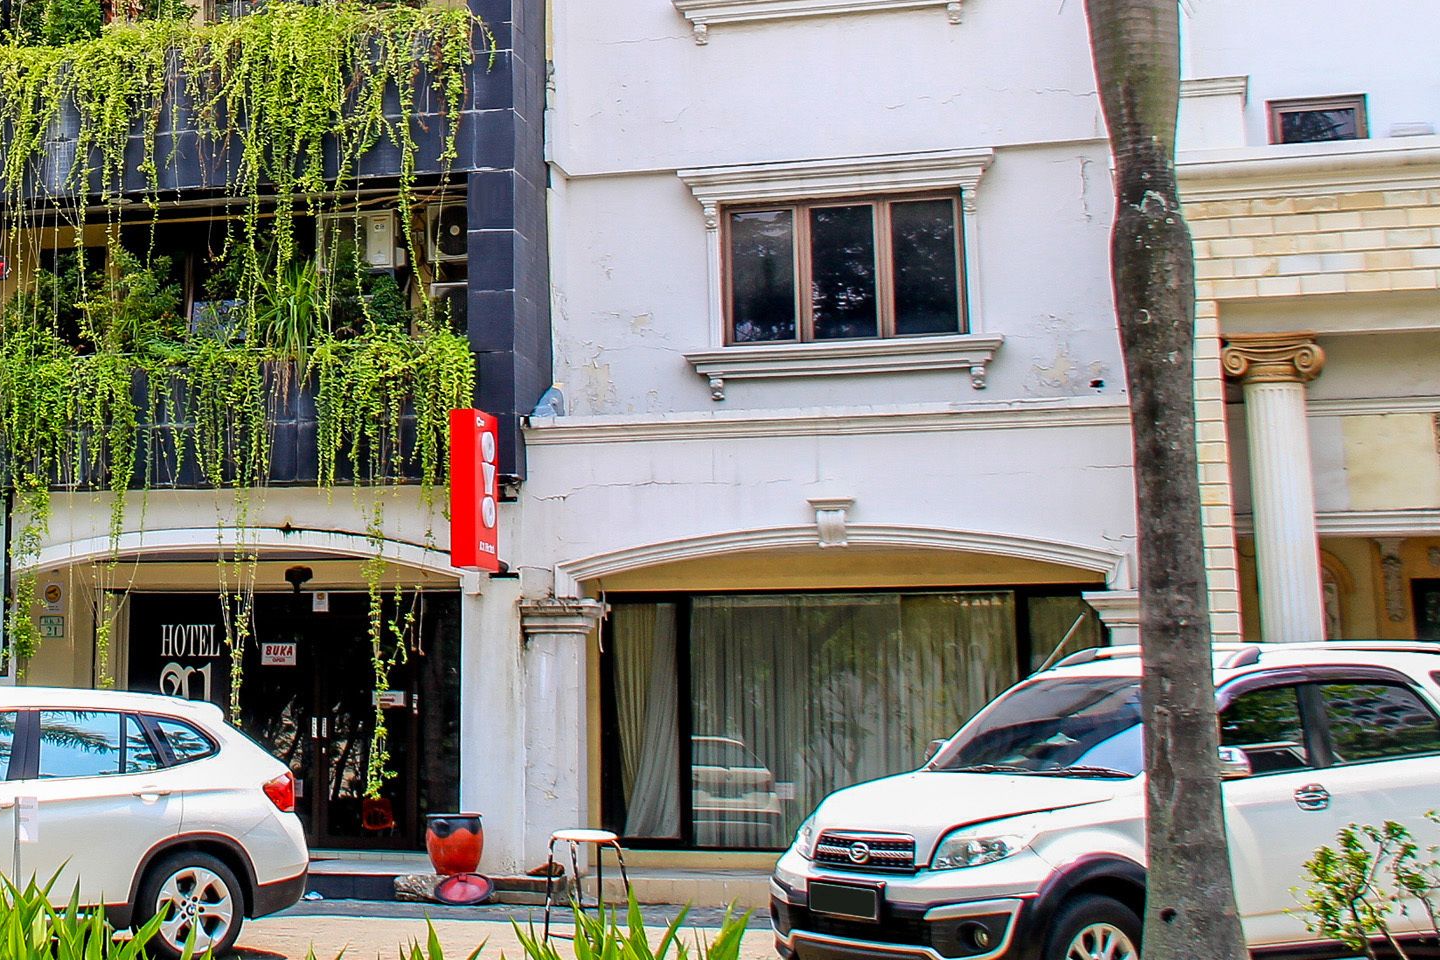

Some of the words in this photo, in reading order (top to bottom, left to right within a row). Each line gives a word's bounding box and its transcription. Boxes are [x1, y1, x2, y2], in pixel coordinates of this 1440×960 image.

[46, 626, 58, 636] 21
[160, 623, 221, 657] HOTEL
[265, 645, 293, 656] BUKA
